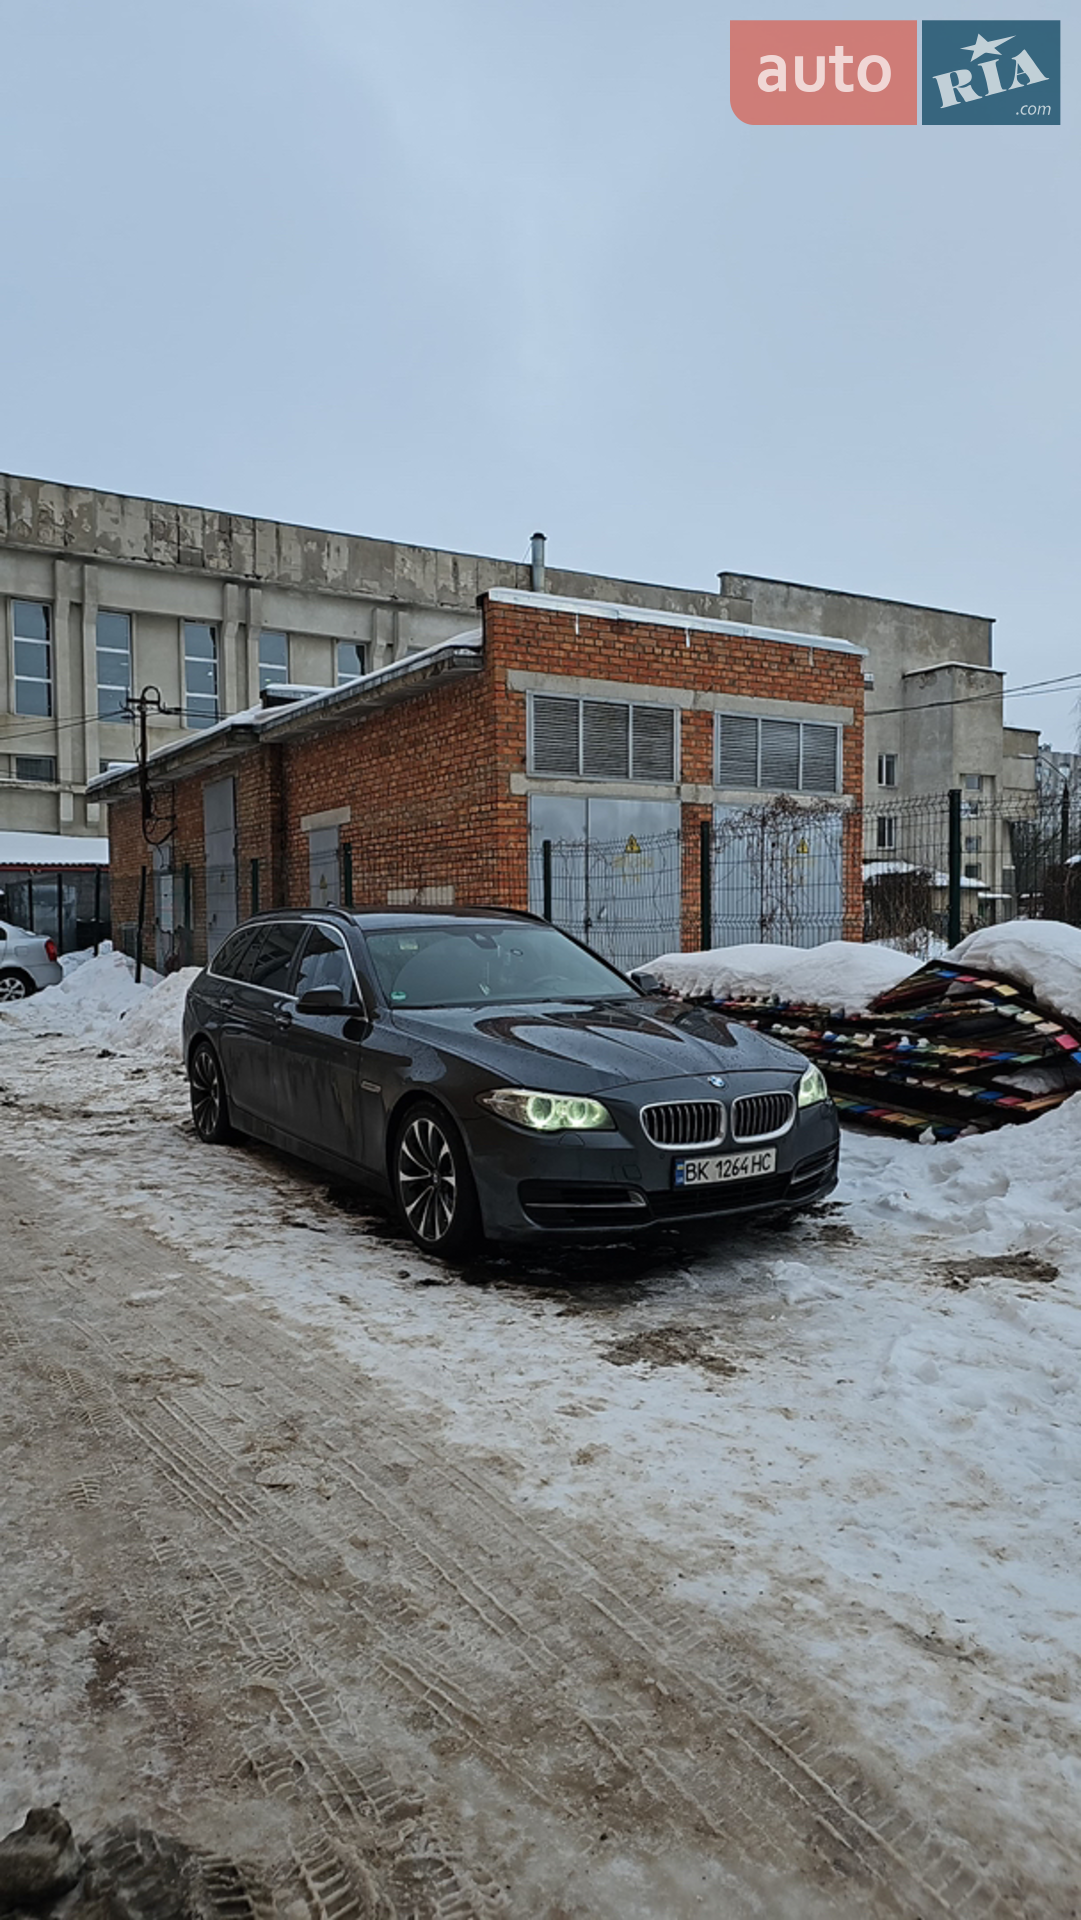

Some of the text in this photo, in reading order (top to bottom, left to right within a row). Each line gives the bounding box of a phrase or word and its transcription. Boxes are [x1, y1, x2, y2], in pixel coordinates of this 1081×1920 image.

[685, 1153, 771, 1182] BK 1264 HC
